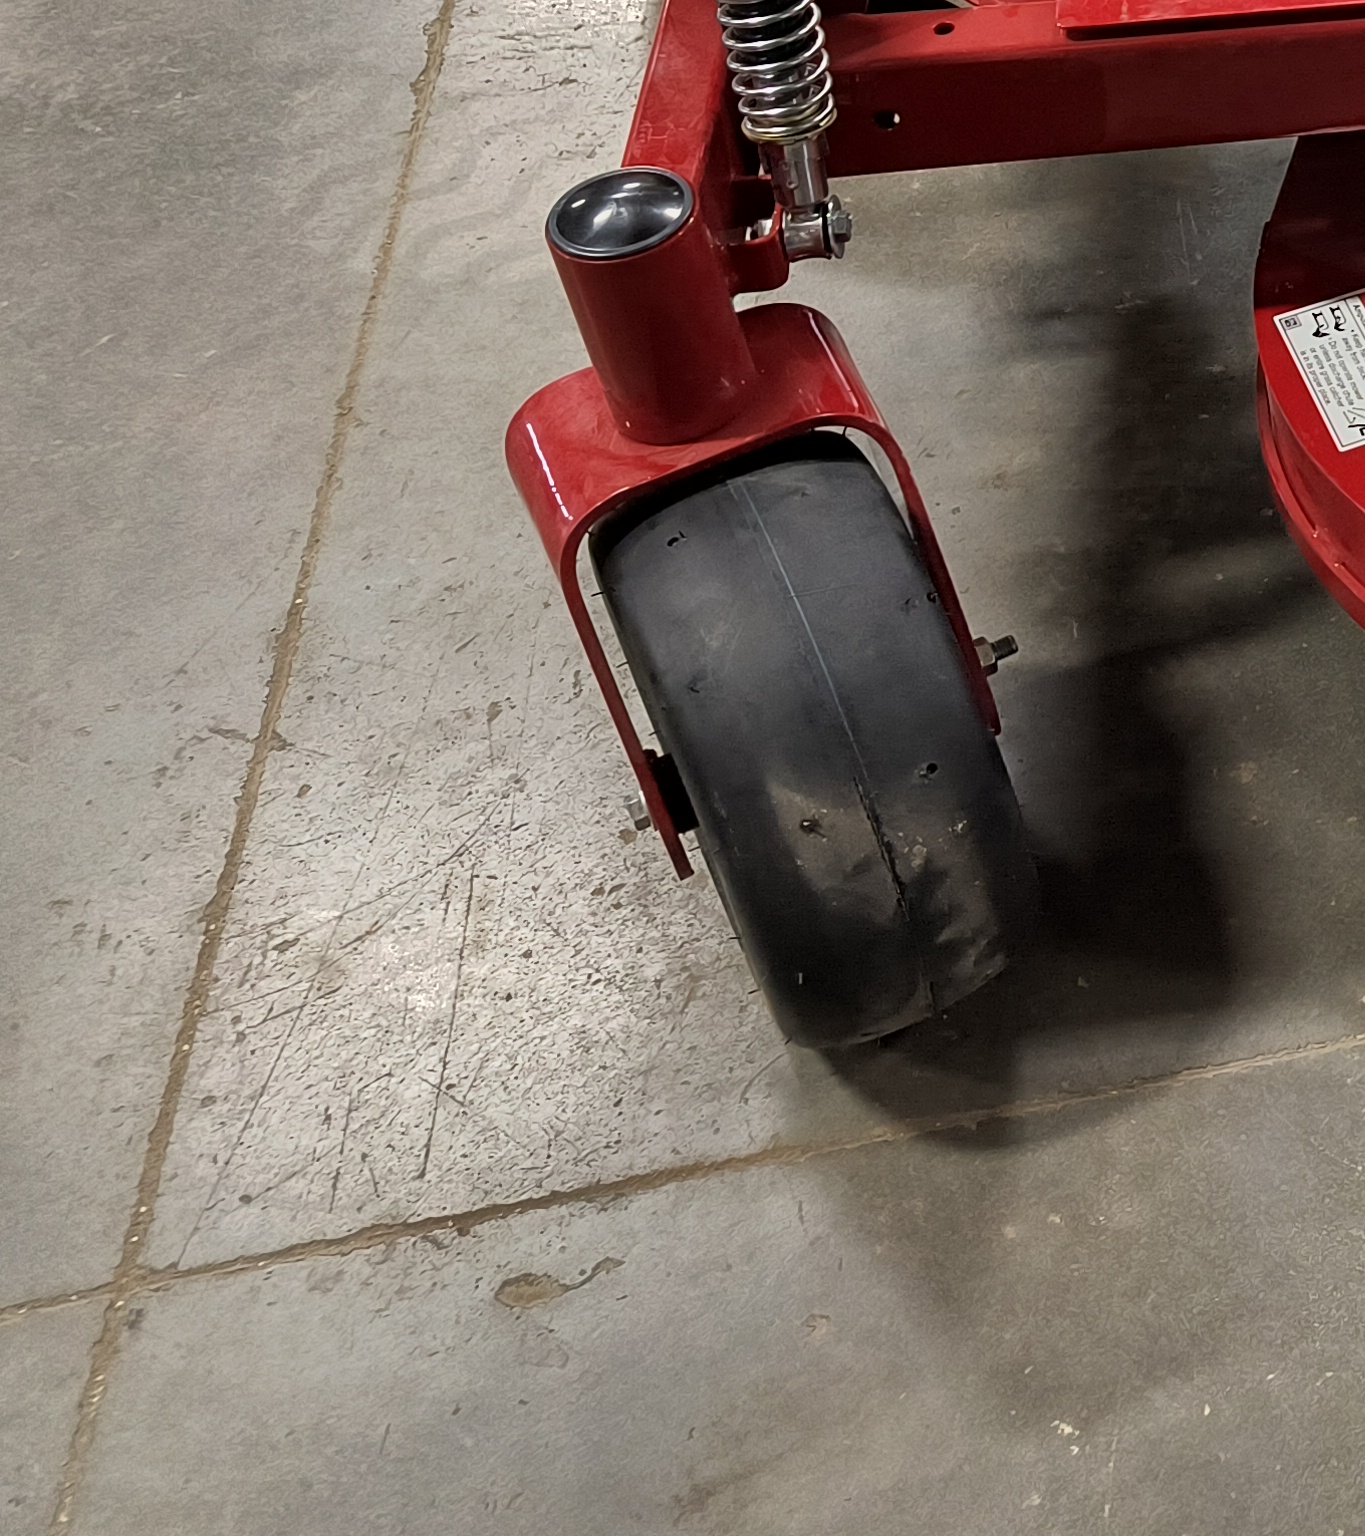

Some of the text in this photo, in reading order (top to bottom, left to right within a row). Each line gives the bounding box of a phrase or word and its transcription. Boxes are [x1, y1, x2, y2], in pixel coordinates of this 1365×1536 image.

[1328, 340, 1339, 350] Do
[1349, 333, 1363, 348] Keep
[1333, 349, 1342, 359] not
[1349, 351, 1361, 364] from
